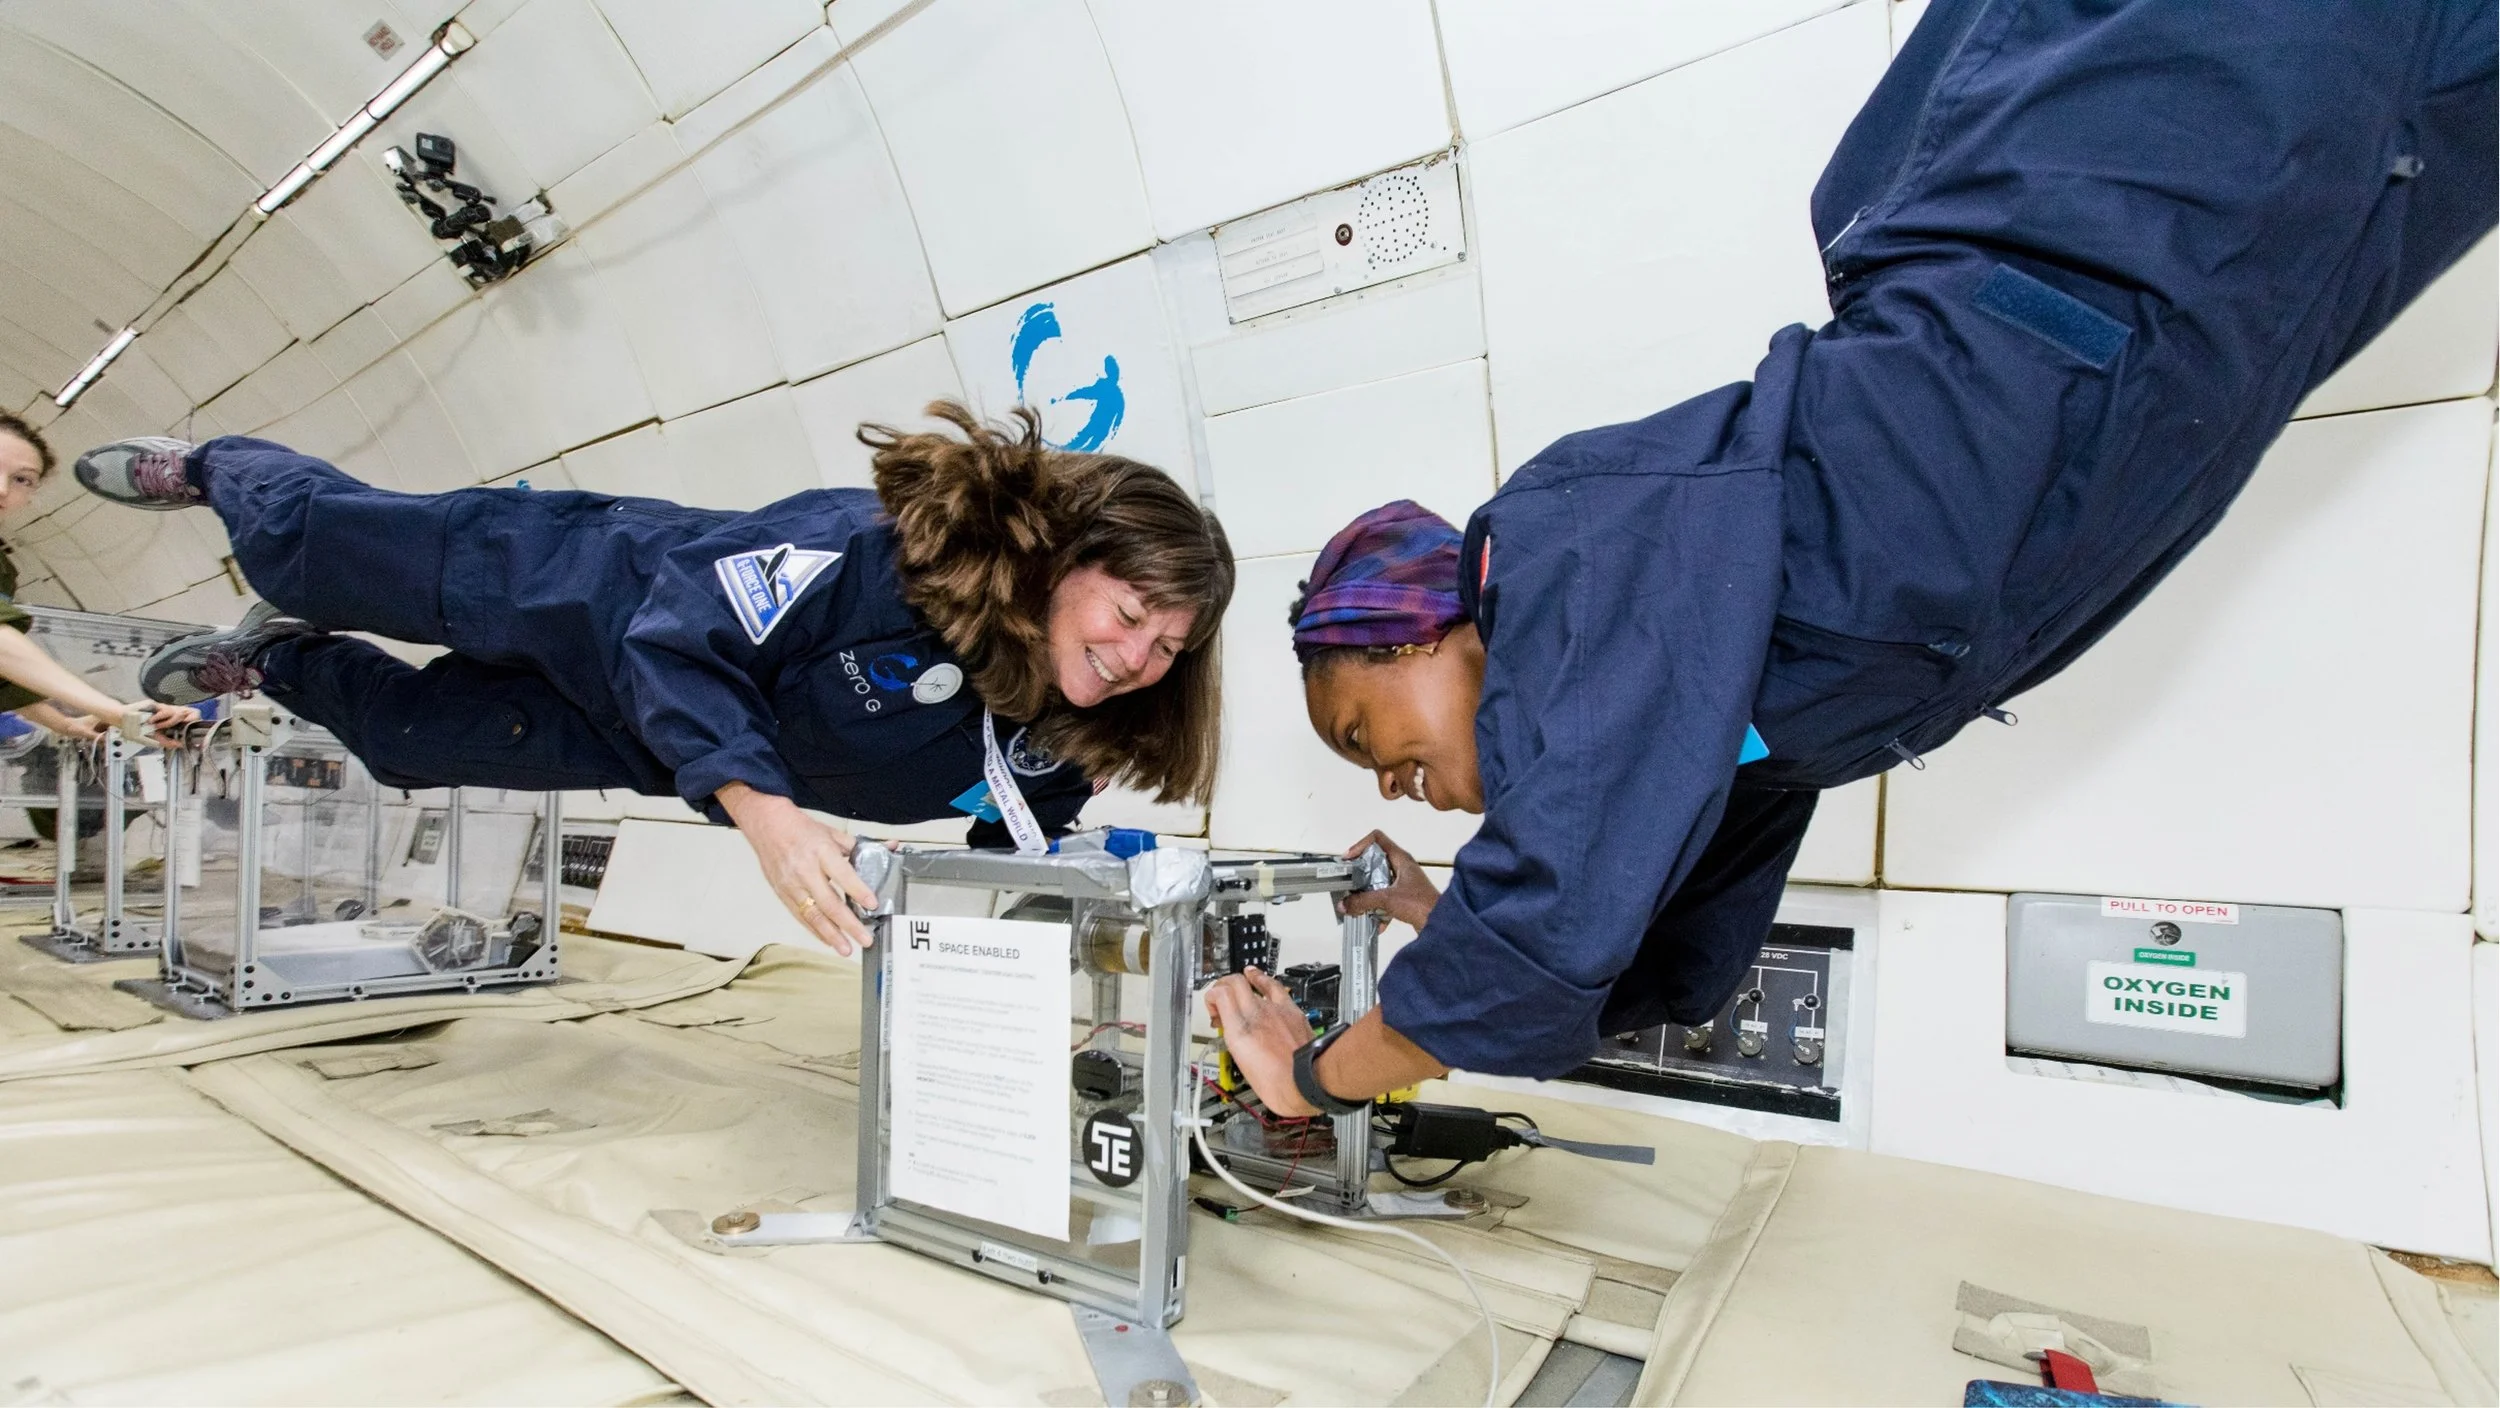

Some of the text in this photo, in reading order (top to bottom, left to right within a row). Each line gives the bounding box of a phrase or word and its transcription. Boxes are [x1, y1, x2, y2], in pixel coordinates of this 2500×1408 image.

[752, 591, 772, 612] ONE
[839, 650, 881, 712] zero G
[992, 776, 1008, 806] METAL
[1007, 808, 1028, 842] WORLD
[2110, 901, 2228, 916] PULL TO OPEN
[938, 942, 1020, 960] SPACE ENABLED
[1772, 952, 1788, 960] VDC
[2138, 952, 2190, 961] OXYGEN INSIDE
[2104, 976, 2230, 1000] OXYGEN
[2114, 997, 2218, 1020] INSIDE
